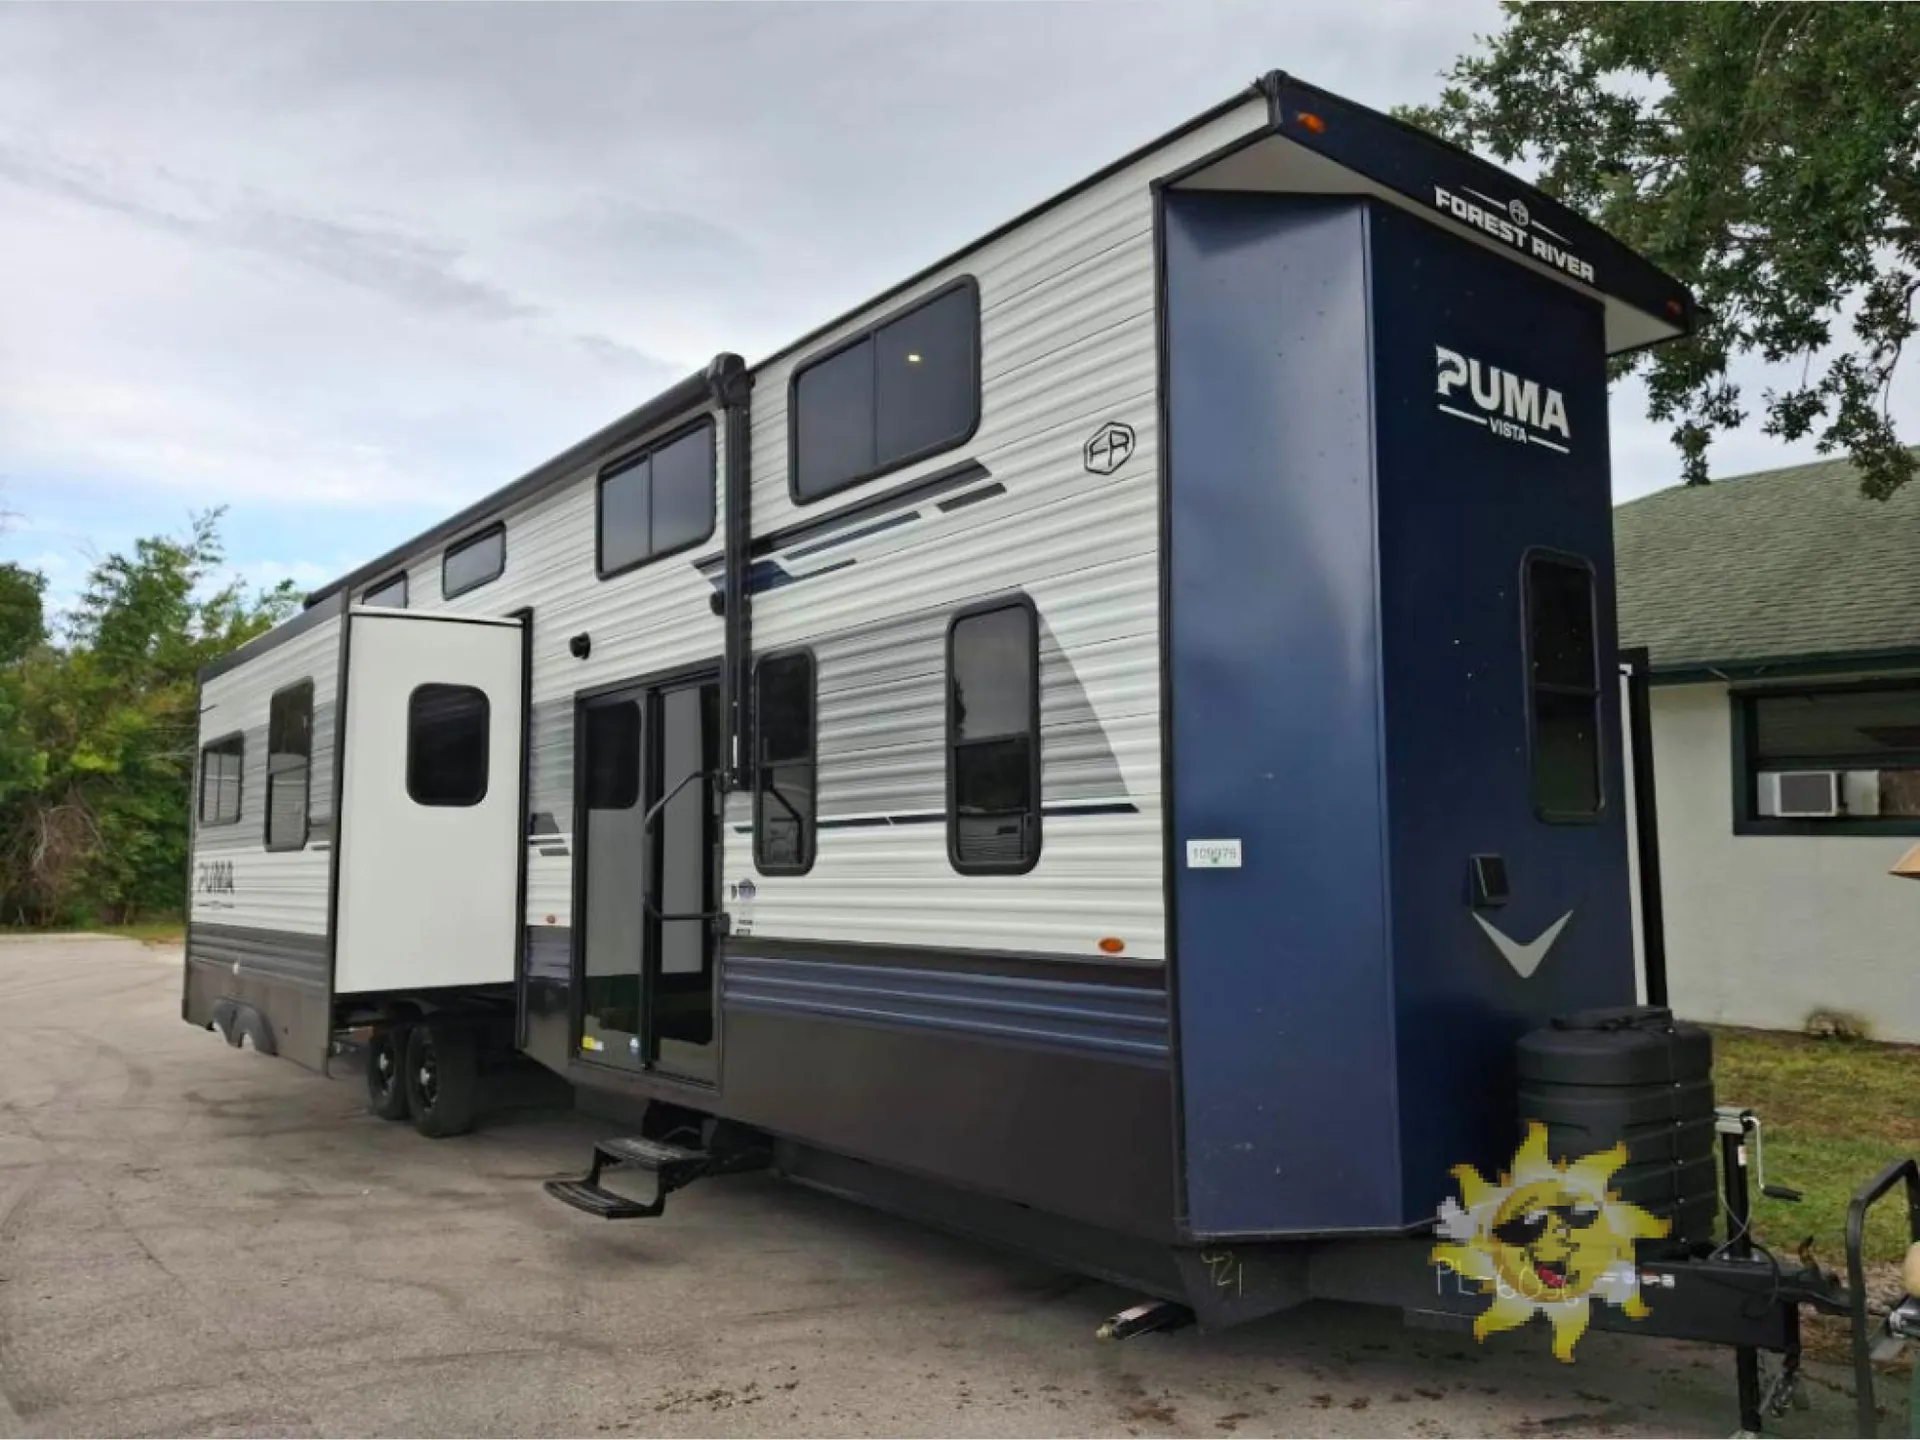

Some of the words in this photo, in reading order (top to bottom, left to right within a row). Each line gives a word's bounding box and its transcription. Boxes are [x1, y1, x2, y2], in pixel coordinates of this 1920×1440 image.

[1434, 184, 1528, 248] FOREST
[1531, 236, 1594, 283] RIVER
[1435, 344, 1571, 439] PUMA
[1487, 415, 1528, 445] VISTA
